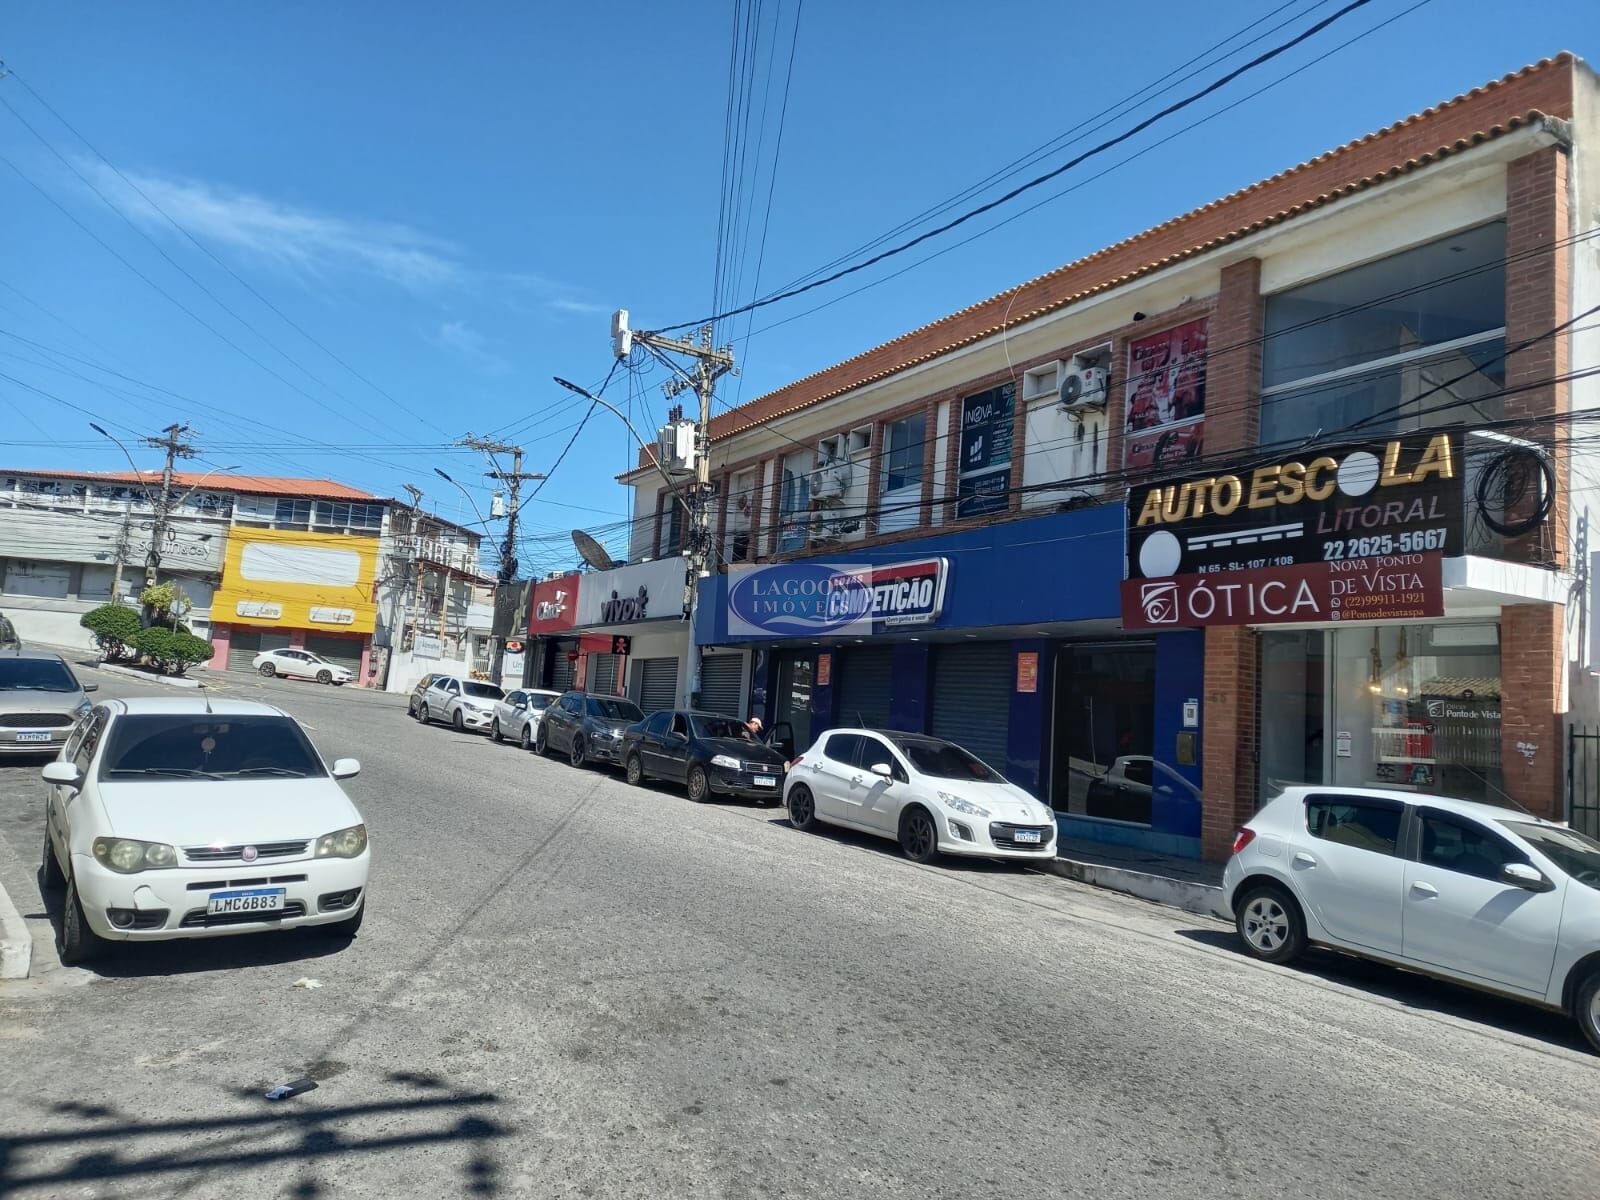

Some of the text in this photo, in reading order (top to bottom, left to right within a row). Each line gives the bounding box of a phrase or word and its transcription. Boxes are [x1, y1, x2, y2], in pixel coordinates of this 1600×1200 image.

[1136, 475, 1242, 526] AUTO
[1316, 495, 1446, 534] LITORAL
[1323, 528, 1447, 561] 22 2625-5667
[1198, 565, 1206, 574] N
[1208, 564, 1221, 573] 65
[1228, 562, 1245, 572] SL:
[1247, 559, 1266, 569] 107
[1274, 555, 1294, 566] 108
[1330, 553, 1423, 573] NOVA PONTO
[1330, 568, 1424, 595] DE VISTA
[601, 590, 634, 623] vivo
[830, 578, 933, 616] COMPETIÇÃO
[1188, 579, 1320, 618] ÓTICA
[1345, 592, 1425, 608] (22)99911-1921
[1446, 709, 1502, 719] Ponto de Vista
[214, 895, 277, 913] LMC6B83
